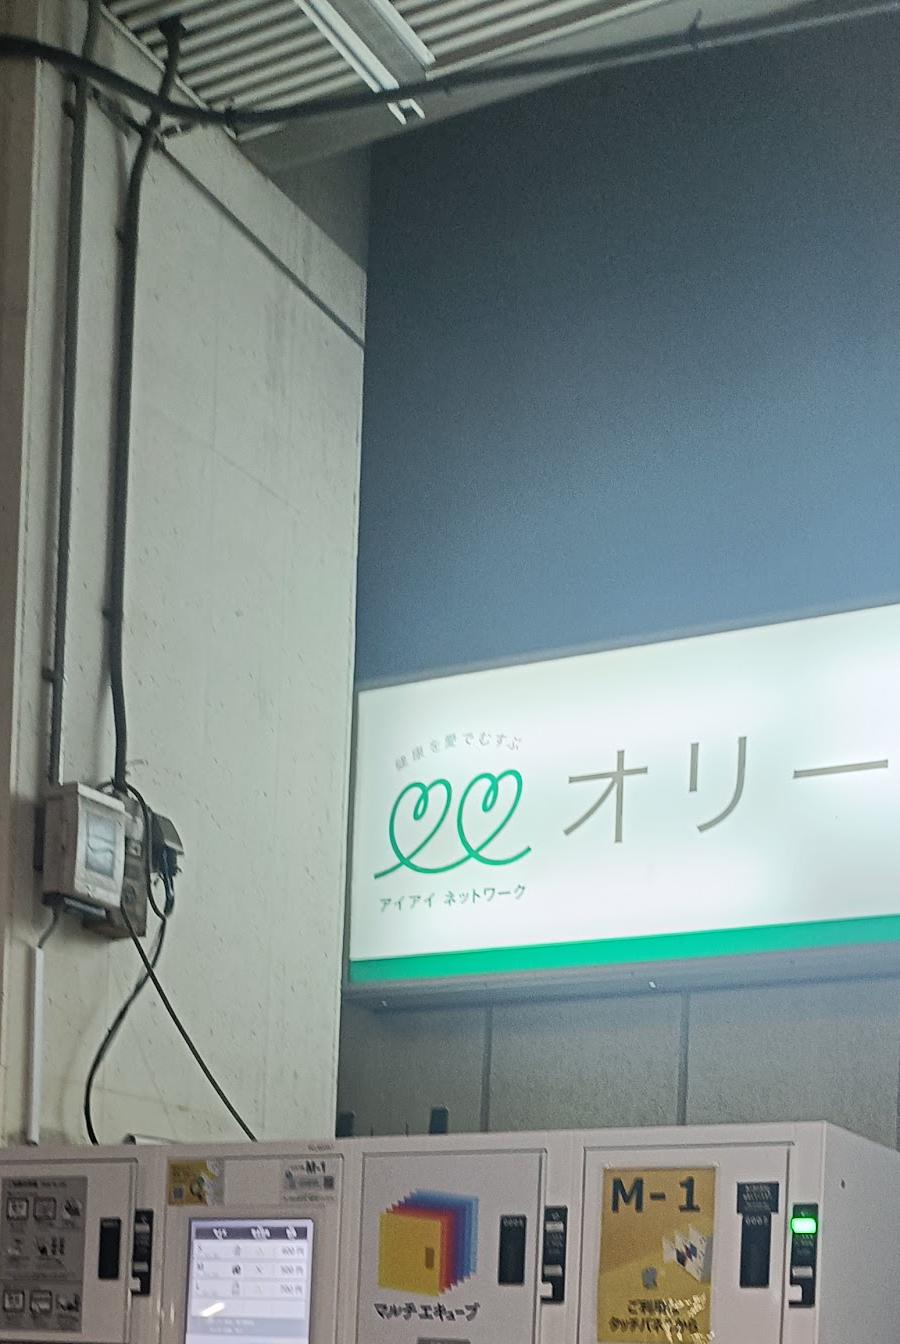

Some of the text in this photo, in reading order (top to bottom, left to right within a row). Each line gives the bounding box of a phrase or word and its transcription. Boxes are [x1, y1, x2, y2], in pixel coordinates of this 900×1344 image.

[379, 884, 527, 912] アイアイ ネットワーク
[611, 1176, 701, 1214] M-1
[373, 1302, 480, 1322] マルチエキューブ
